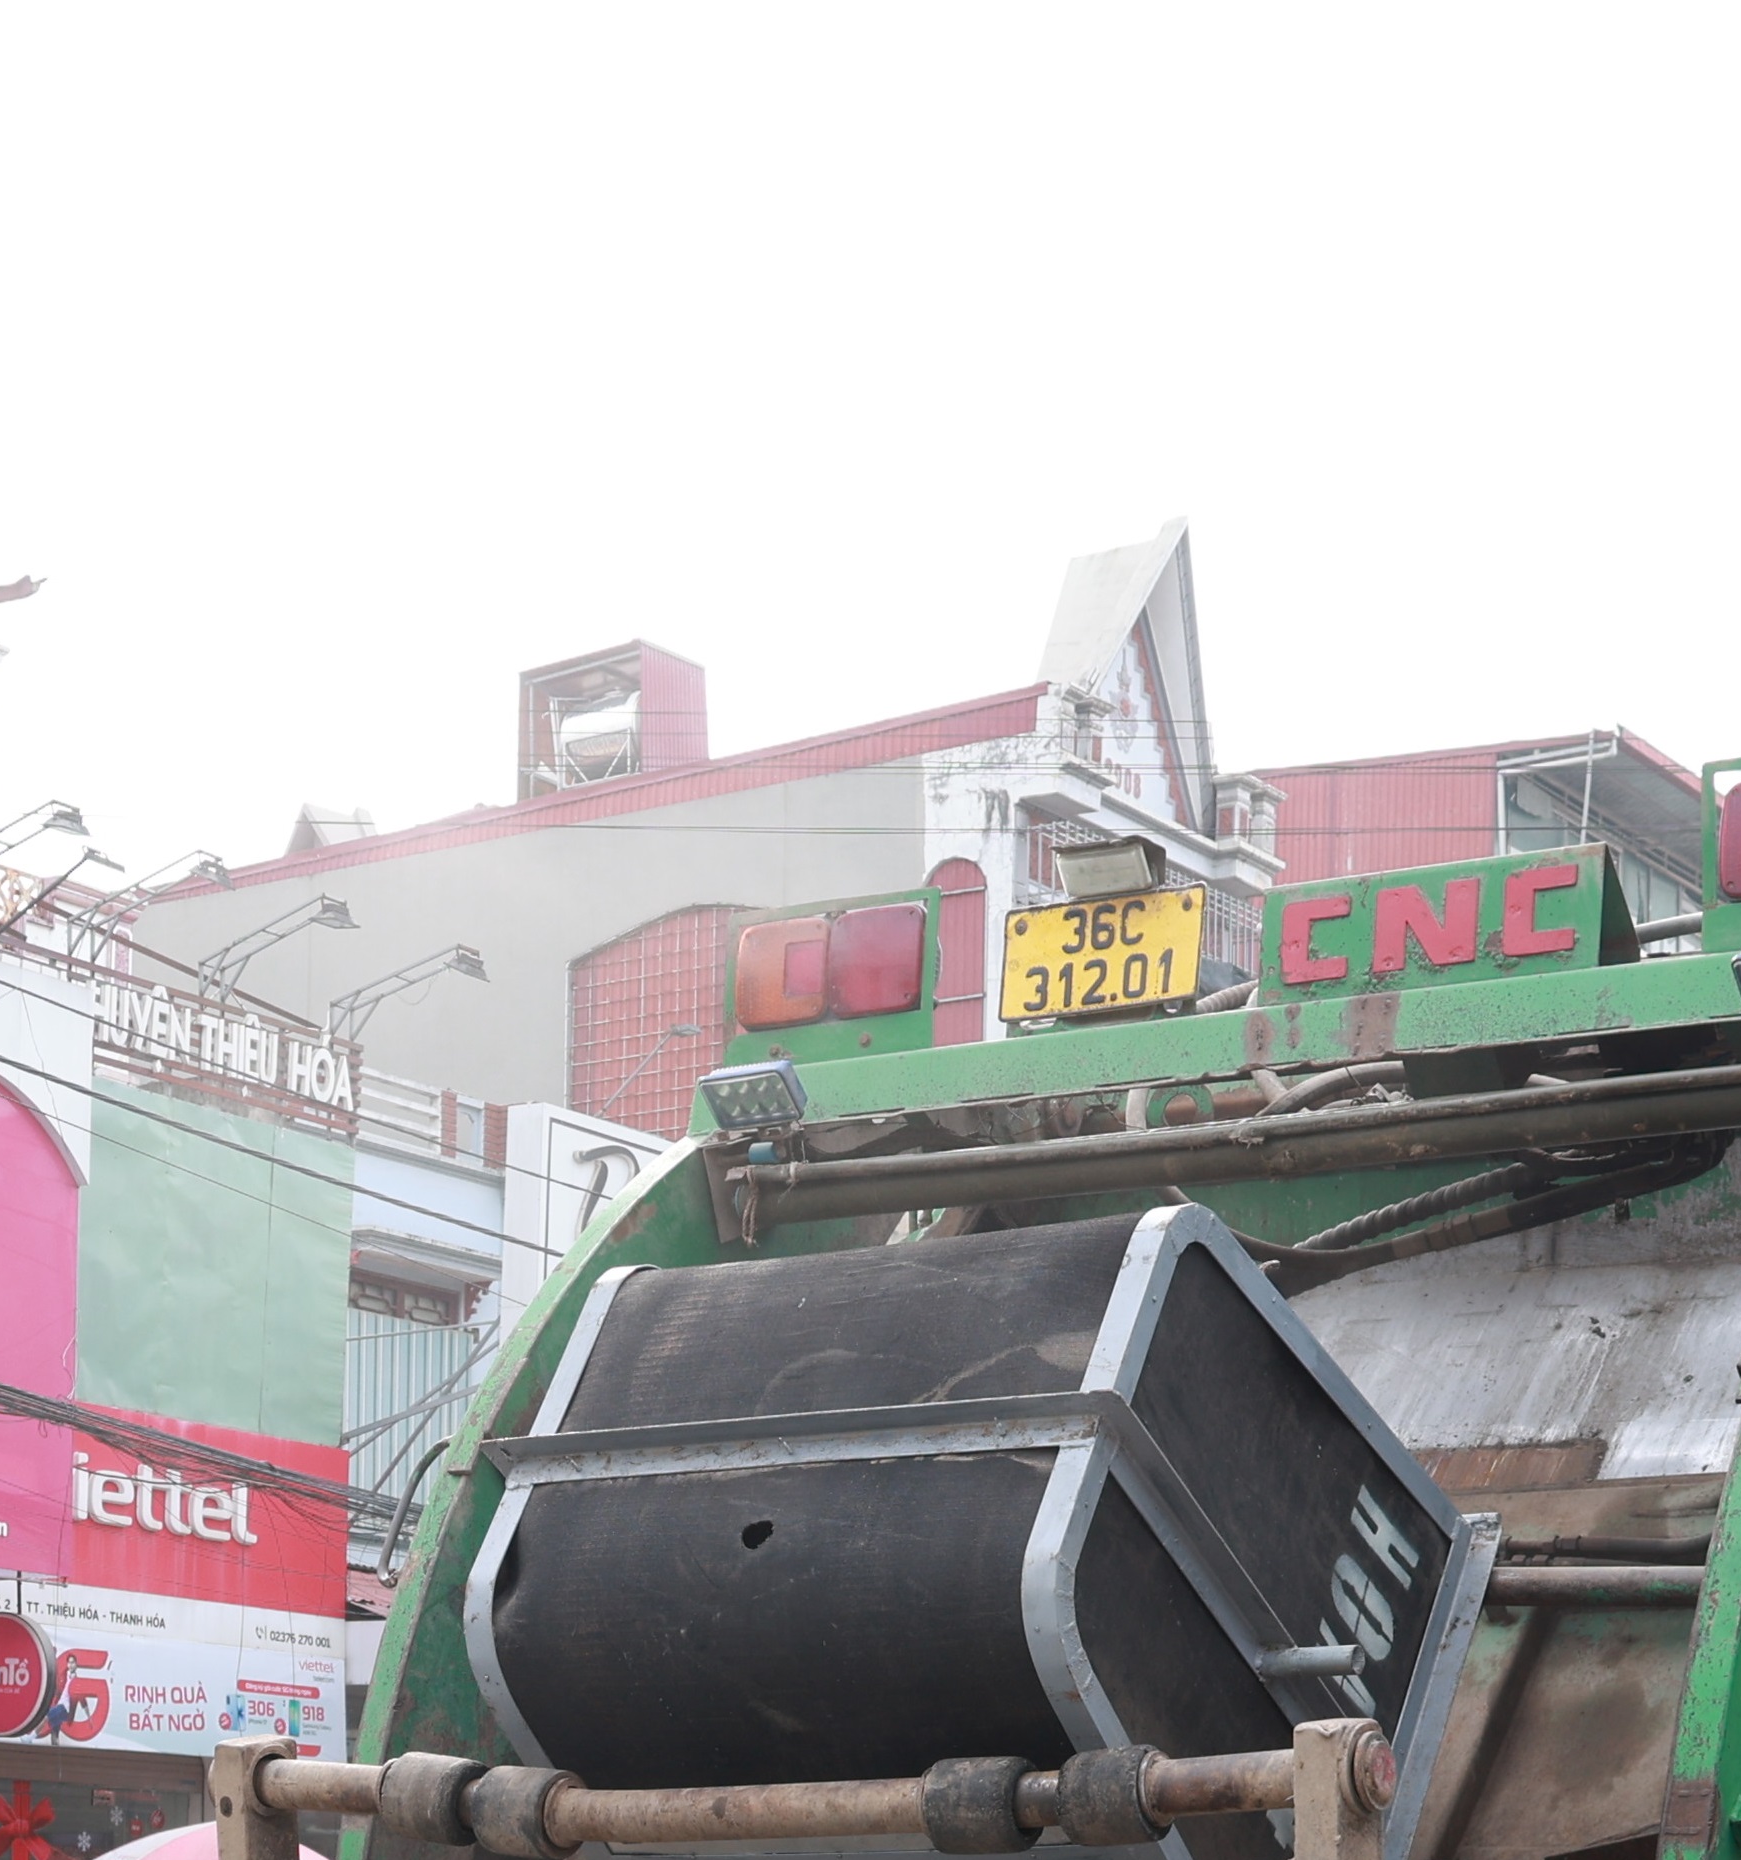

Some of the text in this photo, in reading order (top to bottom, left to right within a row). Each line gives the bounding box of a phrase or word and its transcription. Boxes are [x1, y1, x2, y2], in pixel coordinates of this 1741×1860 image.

[1061, 900, 1147, 954] 36C
[1279, 863, 1579, 986] CNC
[1022, 948, 1174, 1012] 312.01
[197, 1012, 280, 1098] THIỆU
[287, 1030, 355, 1112] HÓA
[71, 1451, 258, 1546] iettel
[4, 1599, 11, 1611] 2
[47, 1602, 76, 1619] THIỆU
[78, 1603, 99, 1621] HÓA
[109, 1611, 143, 1627] THANH
[145, 1612, 166, 1630] HÓA
[269, 1630, 332, 1649] 02376 270 001
[299, 1659, 336, 1674] viettel
[124, 1681, 208, 1704] RINH QUÀ
[128, 1704, 206, 1732] BẤT NGỜ
[248, 1699, 325, 1722] 306 918
